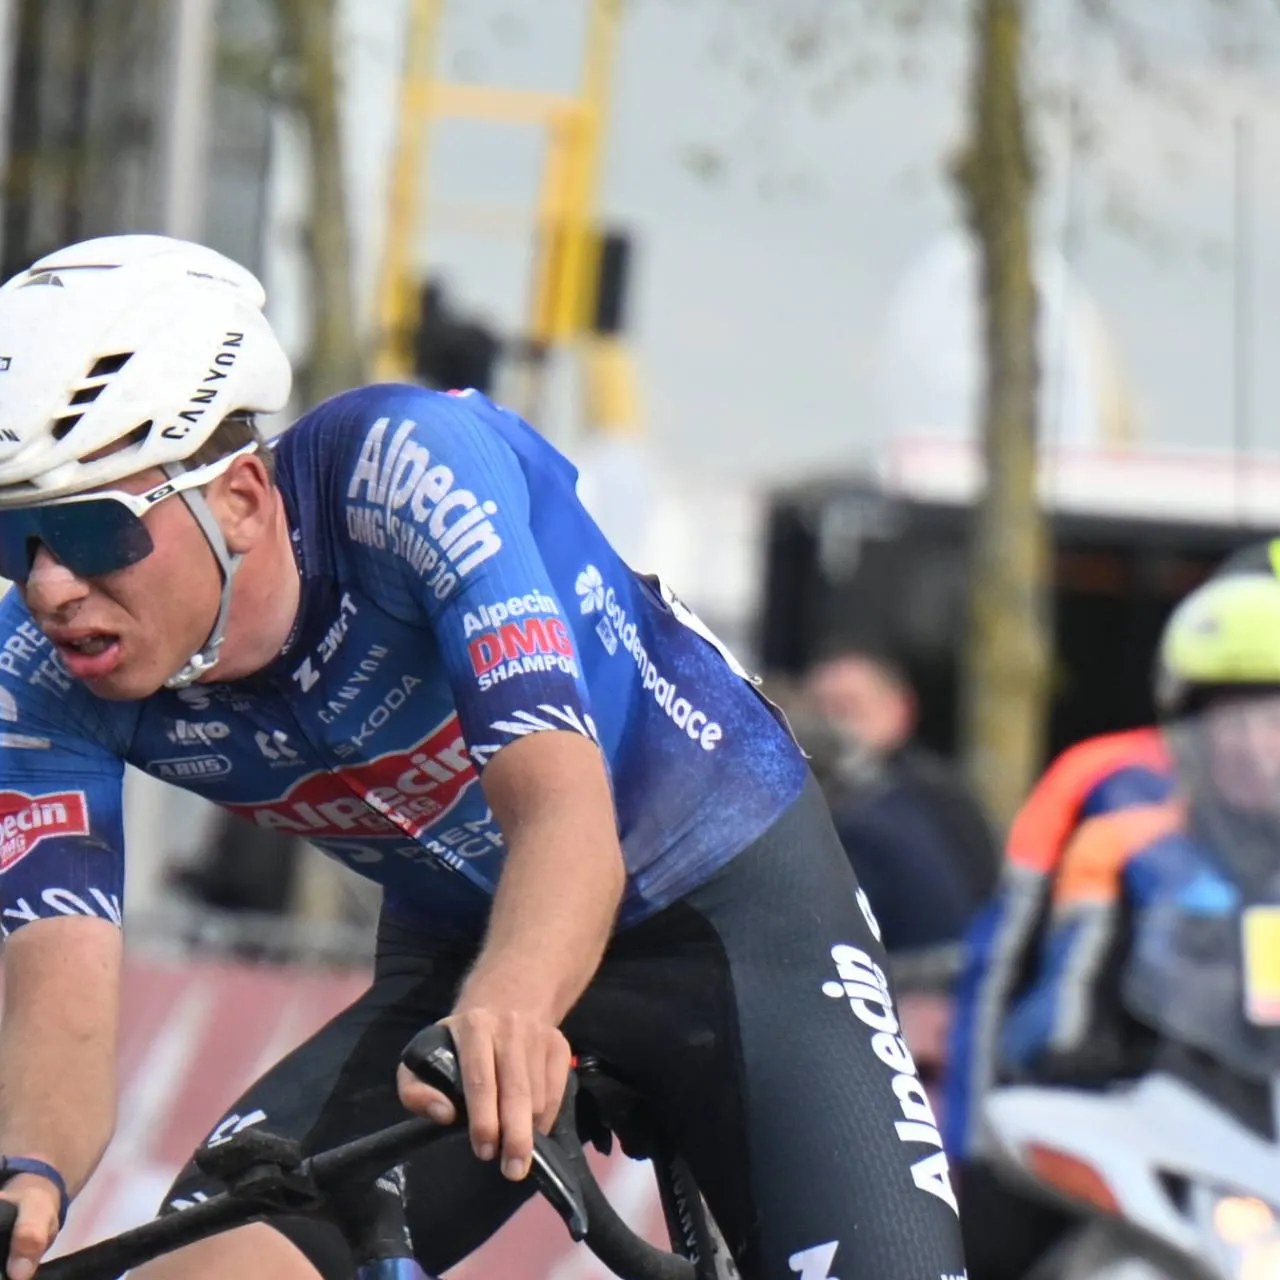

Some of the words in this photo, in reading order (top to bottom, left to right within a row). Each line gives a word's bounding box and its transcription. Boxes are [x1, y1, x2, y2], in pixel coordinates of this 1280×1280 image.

[160, 332, 244, 440] CANYON
[347, 417, 502, 577] Alpecin
[463, 588, 560, 639] Alpecin
[468, 616, 576, 679] DMG
[317, 644, 389, 724] CANYON
[605, 586, 723, 751] Goldenpalace
[822, 943, 960, 1219] Alpecin
